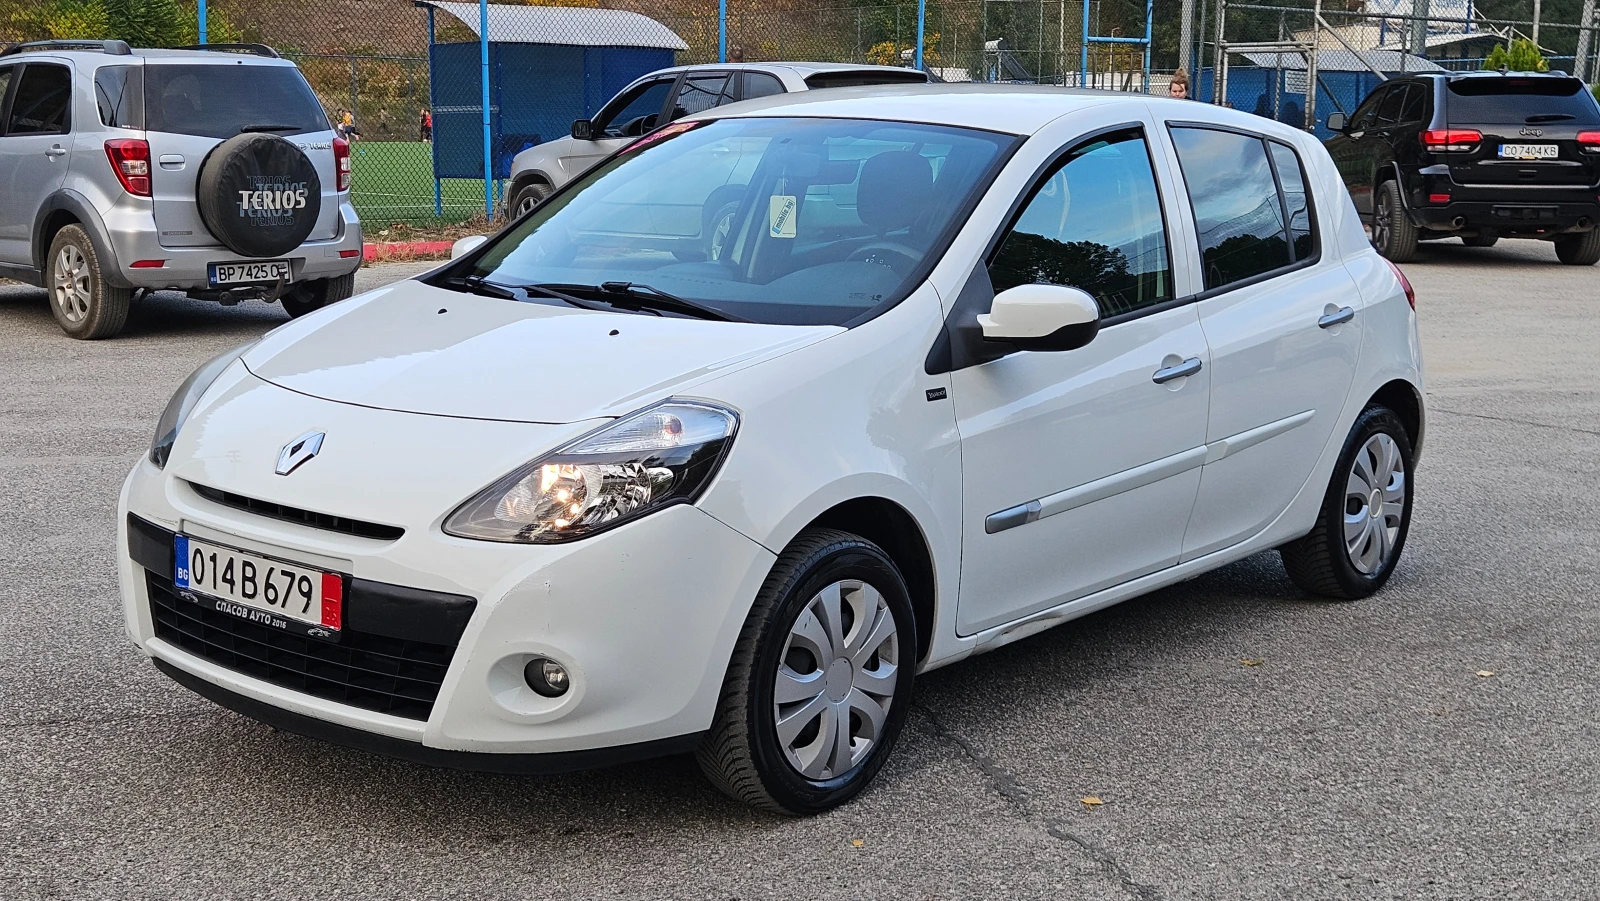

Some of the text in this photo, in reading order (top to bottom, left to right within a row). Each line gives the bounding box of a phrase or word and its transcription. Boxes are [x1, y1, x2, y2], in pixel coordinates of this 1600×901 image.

[1519, 127, 1542, 137] Jeep
[1519, 147, 1542, 156] 7404
[1544, 147, 1557, 156] KB
[239, 190, 306, 210] TERIOS
[218, 265, 236, 281] BP
[237, 265, 268, 280] 7425
[178, 567, 189, 581] BG
[191, 547, 313, 615] 014B679
[215, 600, 287, 629] СПАСОВ АУТО 2016
